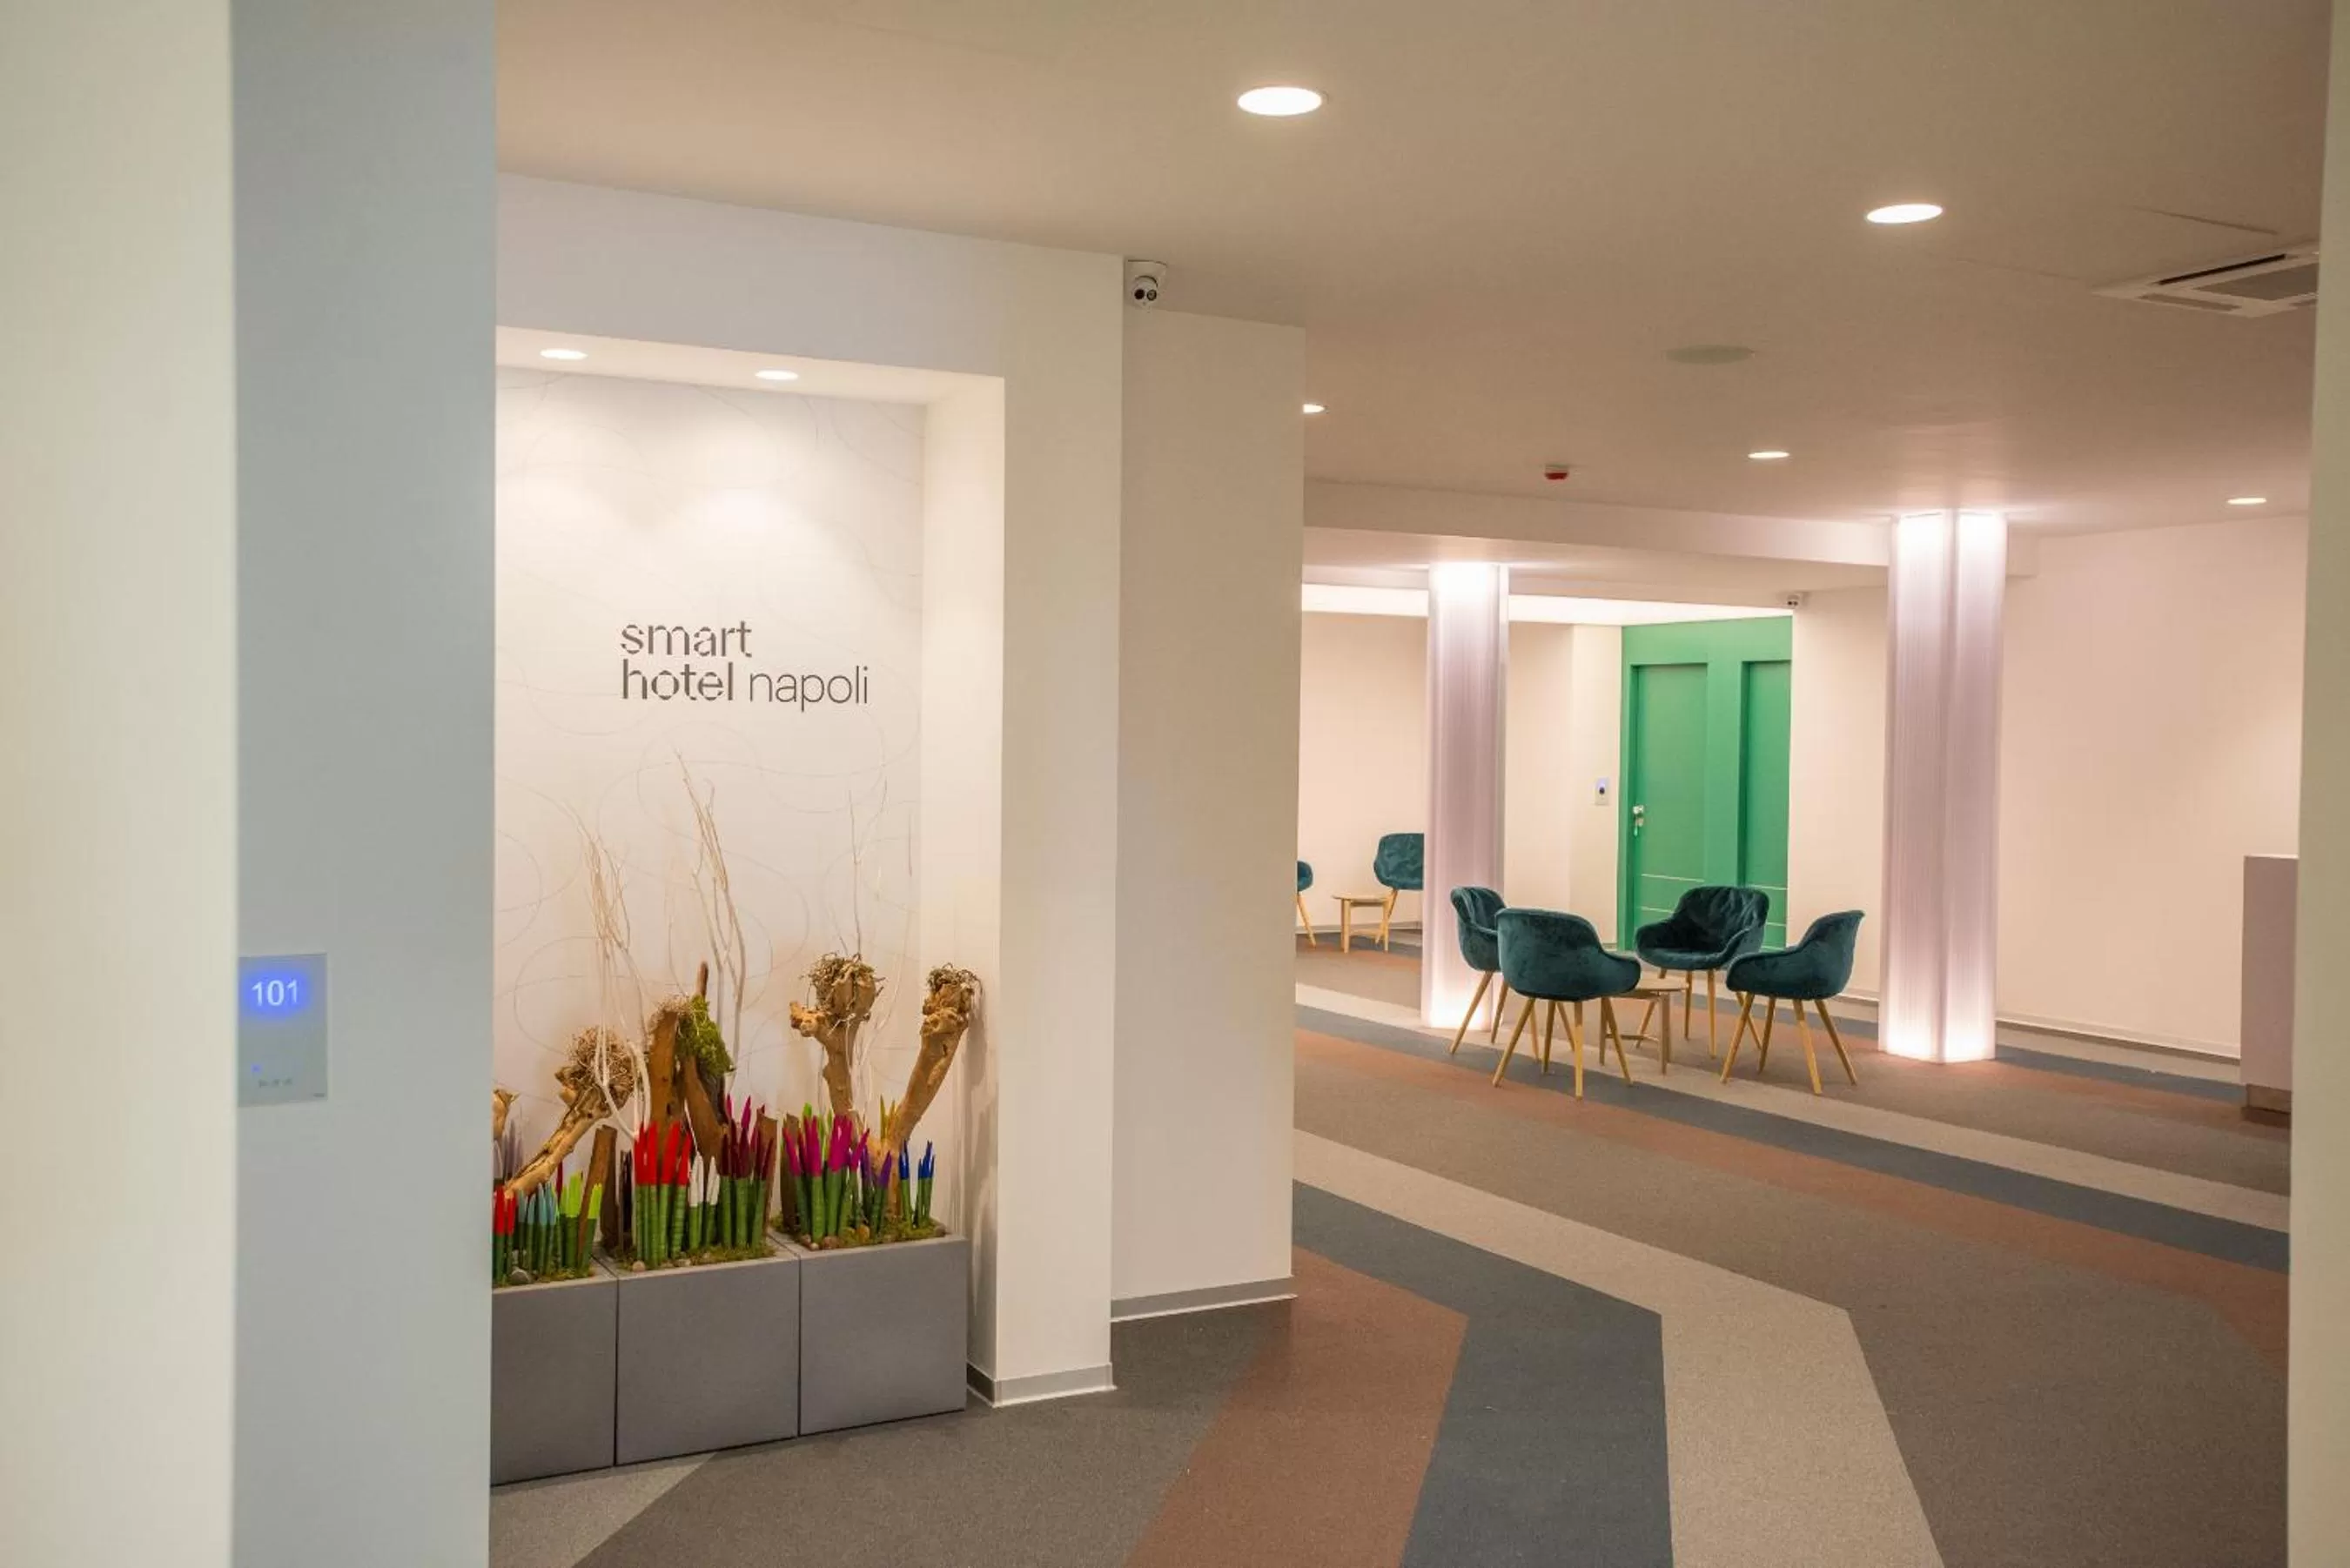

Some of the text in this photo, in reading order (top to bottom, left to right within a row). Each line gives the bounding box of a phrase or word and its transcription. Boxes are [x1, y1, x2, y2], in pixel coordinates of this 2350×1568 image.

[621, 620, 752, 658] smart
[621, 658, 869, 713] hotel napoli
[252, 978, 299, 1007] 101
